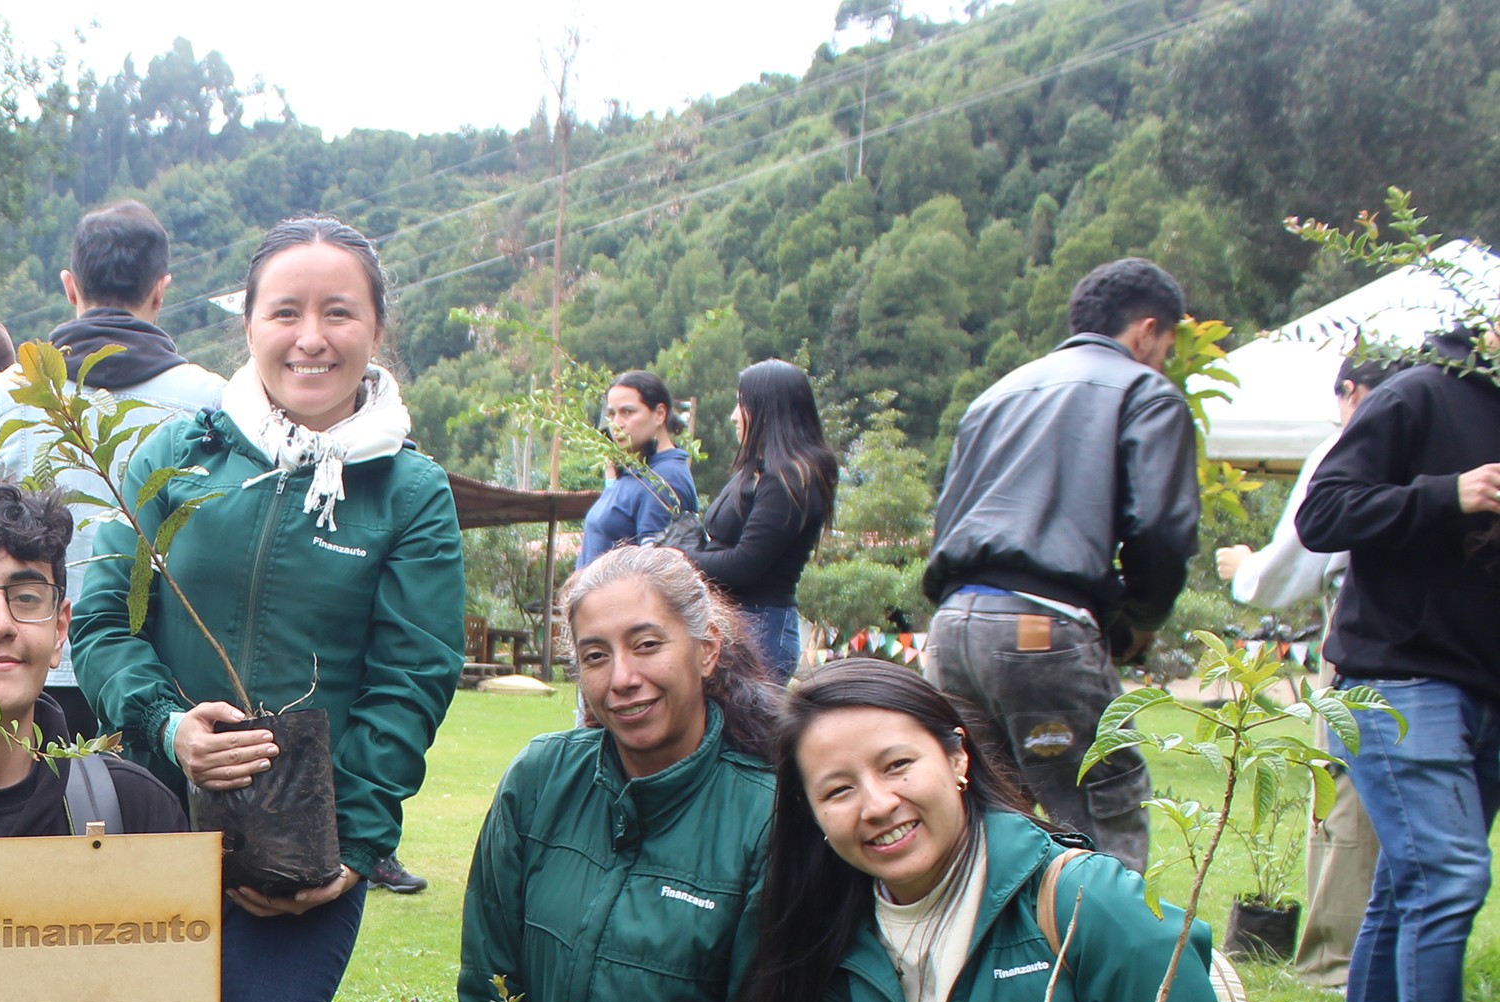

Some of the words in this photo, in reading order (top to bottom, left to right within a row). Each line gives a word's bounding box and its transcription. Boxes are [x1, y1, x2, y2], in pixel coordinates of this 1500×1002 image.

[312, 536, 367, 557] Finanzauto
[660, 886, 716, 910] Finanzauto
[993, 961, 1050, 979] Finanzauto
